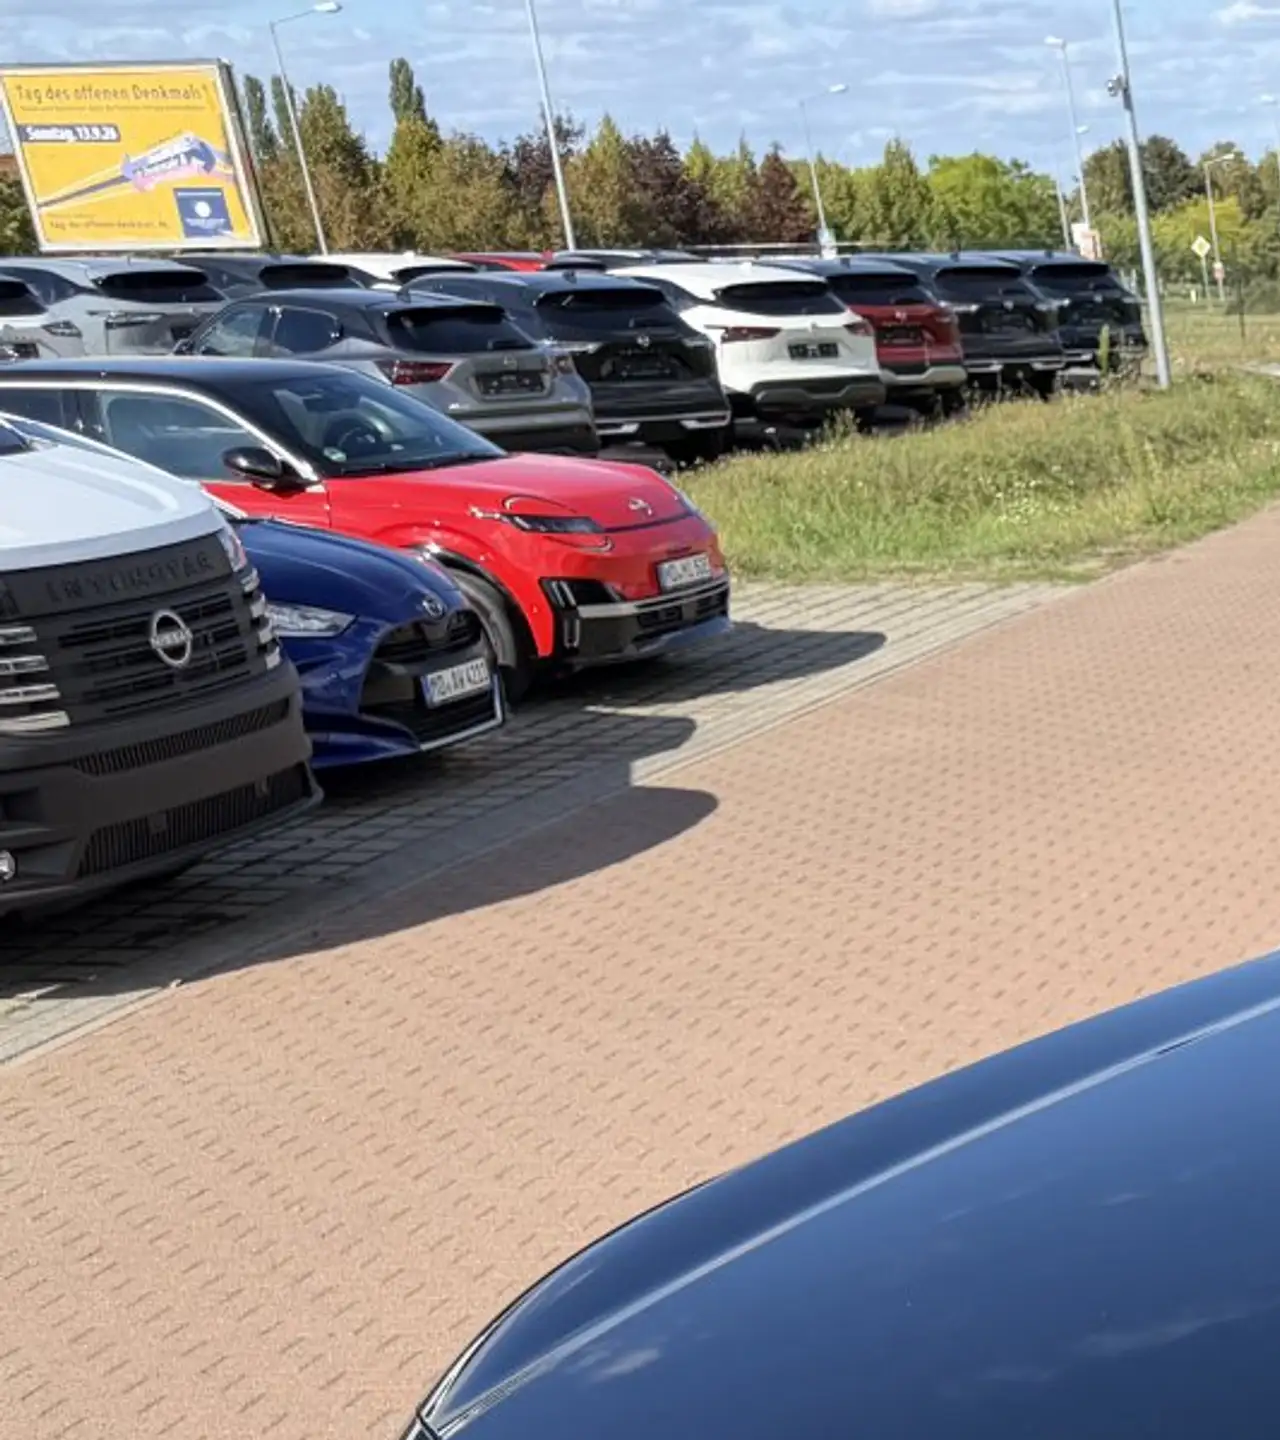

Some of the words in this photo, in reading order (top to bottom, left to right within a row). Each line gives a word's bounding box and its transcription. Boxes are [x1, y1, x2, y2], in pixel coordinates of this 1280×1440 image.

[16, 85, 42, 103] Tag
[46, 84, 70, 100] des
[74, 84, 128, 100] offenen
